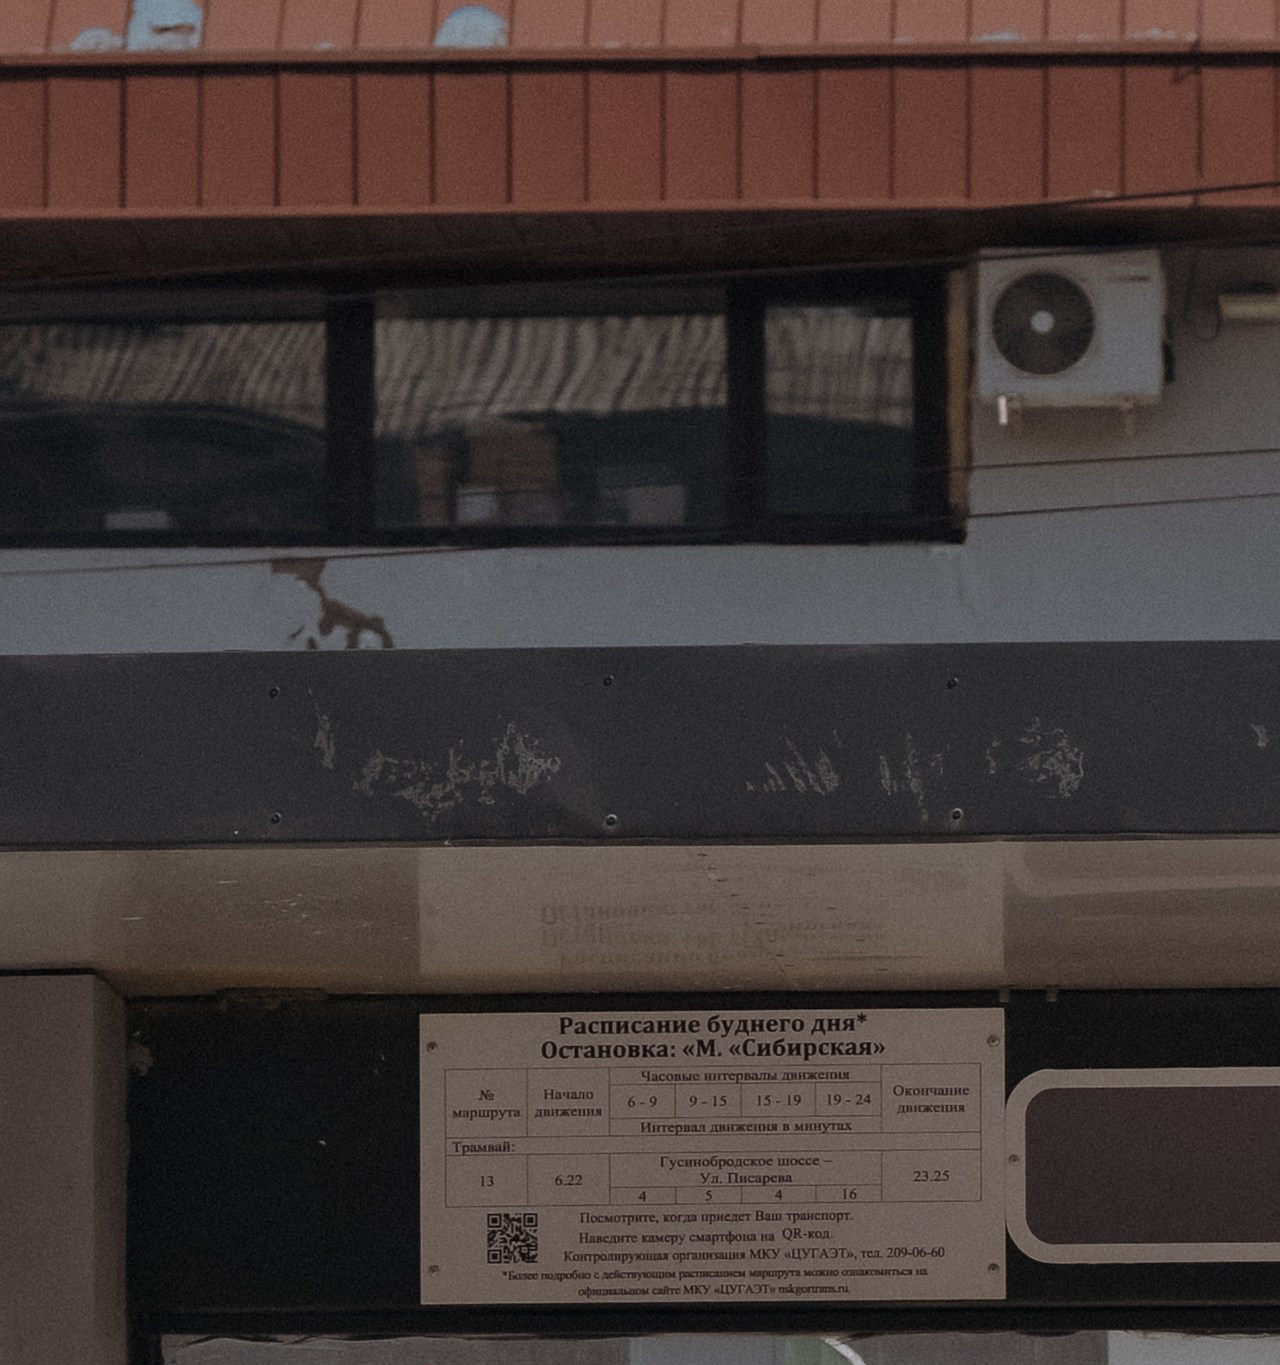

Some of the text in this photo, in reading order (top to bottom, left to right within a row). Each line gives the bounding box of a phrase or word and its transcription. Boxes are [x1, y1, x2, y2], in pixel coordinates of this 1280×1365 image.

[560, 1017, 701, 1035] Расписание
[708, 1015, 805, 1038] буднего
[541, 1038, 885, 1061] Остановка: «М. «Сибирская»
[641, 1070, 850, 1083] Часовые интервалы движения
[478, 1089, 494, 1101] №
[544, 1089, 594, 1100] Начало
[893, 1085, 970, 1096] Окончание
[627, 1096, 636, 1107] 6
[649, 1095, 658, 1107] 9
[689, 1095, 698, 1107] 9
[713, 1095, 727, 1107] 15
[757, 1094, 771, 1106] 15
[787, 1094, 802, 1106] 19
[827, 1094, 842, 1106] 19
[855, 1094, 871, 1105] 24
[452, 1109, 521, 1121] маршрута
[534, 1108, 602, 1118] движения
[896, 1104, 965, 1114] движения
[641, 1122, 853, 1134] Интервал движения в минутах
[452, 1141, 515, 1154] Трамвай:
[660, 1155, 773, 1171] Гусинобродское
[777, 1157, 820, 1166] шоссе
[481, 1175, 494, 1187] 13
[554, 1174, 583, 1186] 6.22
[700, 1172, 793, 1185] Ул. Писарева
[913, 1170, 950, 1182] 23.25
[638, 1191, 647, 1202] 4
[705, 1190, 713, 1201] 5
[774, 1189, 783, 1200] 4
[843, 1188, 857, 1200] 16
[580, 1210, 853, 1226] Посмотрите, когда приедет Ваш транспорт.
[579, 1232, 638, 1244] Наведите
[641, 1234, 686, 1246] камеру
[689, 1230, 757, 1244] смартфона
[760, 1233, 775, 1242] на
[564, 1251, 669, 1264] Контролирующая
[672, 1252, 746, 1263] организация
[749, 1248, 781, 1260] МКУ
[860, 1250, 883, 1259] тел.
[886, 1246, 945, 1258] 209-06-60
[541, 1270, 591, 1282] подробно
[593, 1271, 600, 1280] с
[602, 1270, 675, 1282] действующим
[678, 1270, 746, 1281] расписанием
[749, 1269, 801, 1280] маршрута
[803, 1269, 840, 1277] можно
[915, 1268, 928, 1276] на
[651, 1285, 681, 1295] сайте
[683, 1284, 711, 1295] МКУ
